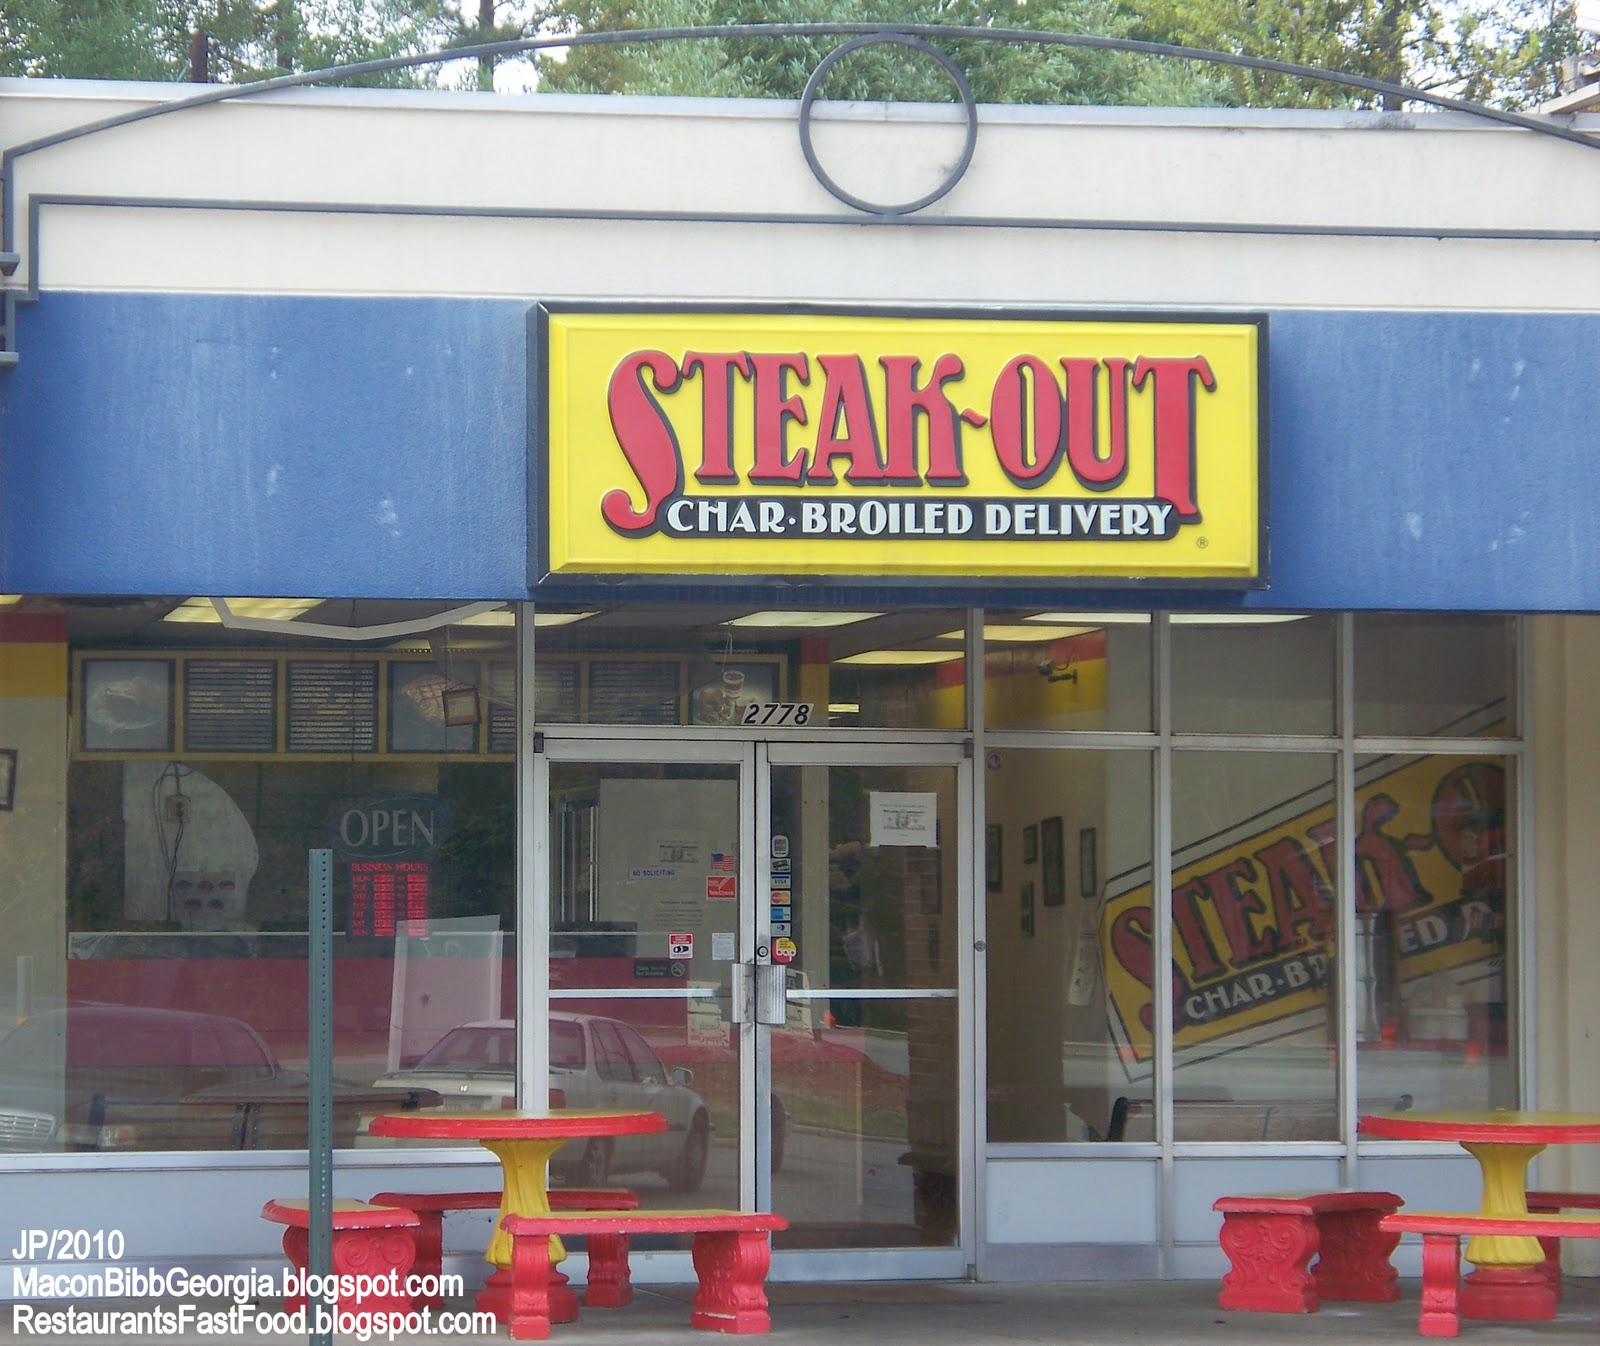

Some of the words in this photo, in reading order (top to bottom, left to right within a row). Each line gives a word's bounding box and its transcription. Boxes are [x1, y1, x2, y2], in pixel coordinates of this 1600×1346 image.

[601, 349, 1216, 539] STEAK-OUT
[984, 503, 1174, 538] DELIVERY
[744, 704, 811, 725] 2778
[340, 809, 435, 847] OPEN
[351, 863, 392, 871] BUSINESS
[394, 863, 428, 871] HOURS
